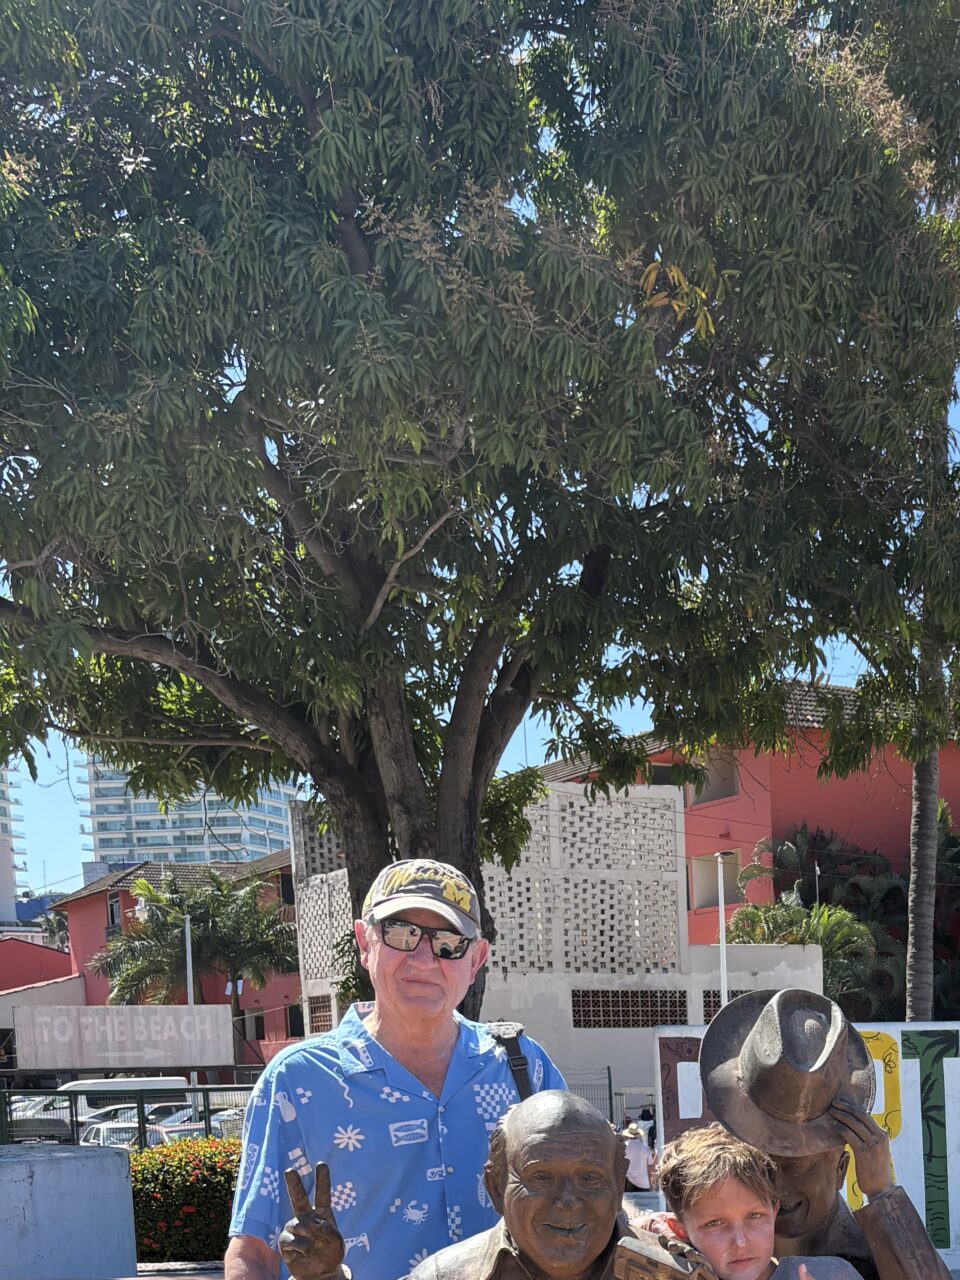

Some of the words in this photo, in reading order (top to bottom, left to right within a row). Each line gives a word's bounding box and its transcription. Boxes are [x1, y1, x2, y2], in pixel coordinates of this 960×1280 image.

[440, 878, 472, 913] M
[37, 1016, 74, 1043] TO
[80, 1016, 126, 1043] THE
[134, 1015, 213, 1042] BEACH
